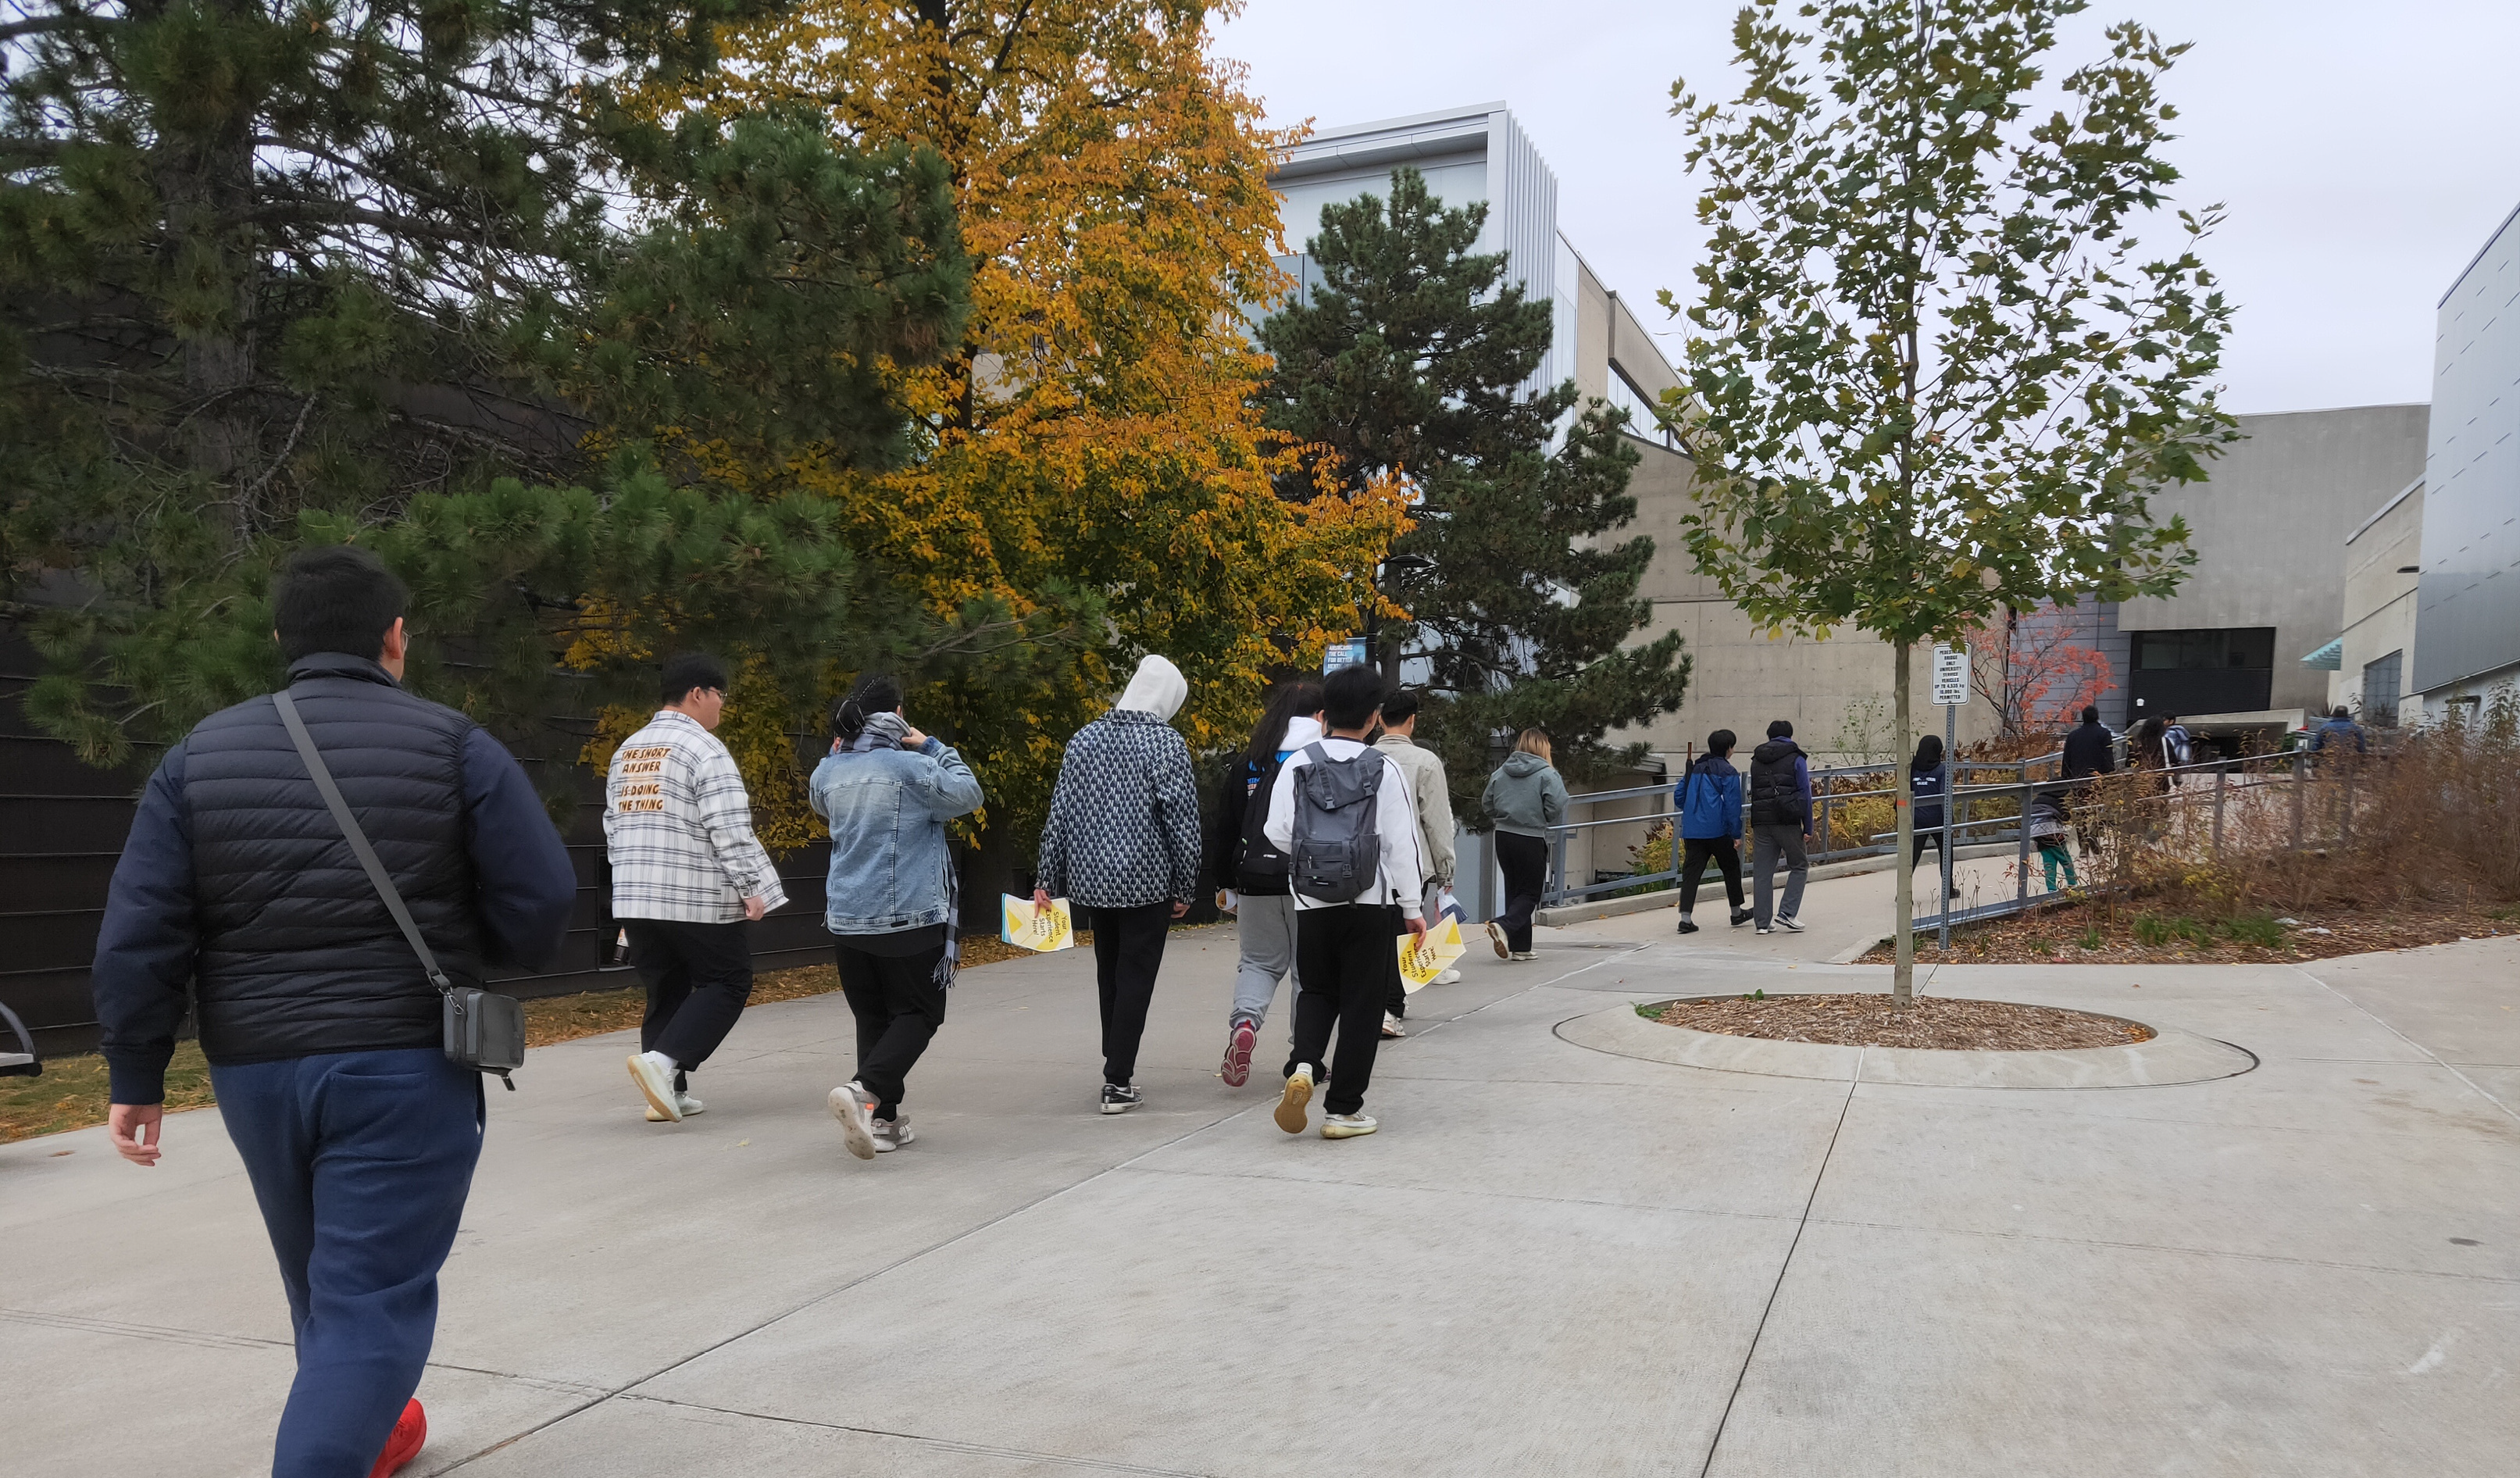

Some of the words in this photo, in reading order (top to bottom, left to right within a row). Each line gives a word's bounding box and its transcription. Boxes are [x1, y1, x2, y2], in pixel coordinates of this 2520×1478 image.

[622, 749, 639, 761] THE
[639, 748, 671, 759] SHORT
[622, 761, 661, 773] ANSWER
[621, 785, 630, 797] IS
[631, 784, 660, 796] DOING
[618, 800, 634, 812] THE
[635, 798, 663, 811] THING
[1045, 909, 1054, 943] Experience
[1422, 949, 1431, 967] Starts
[1428, 946, 1437, 962] Here!
[1407, 950, 1419, 977] Student
